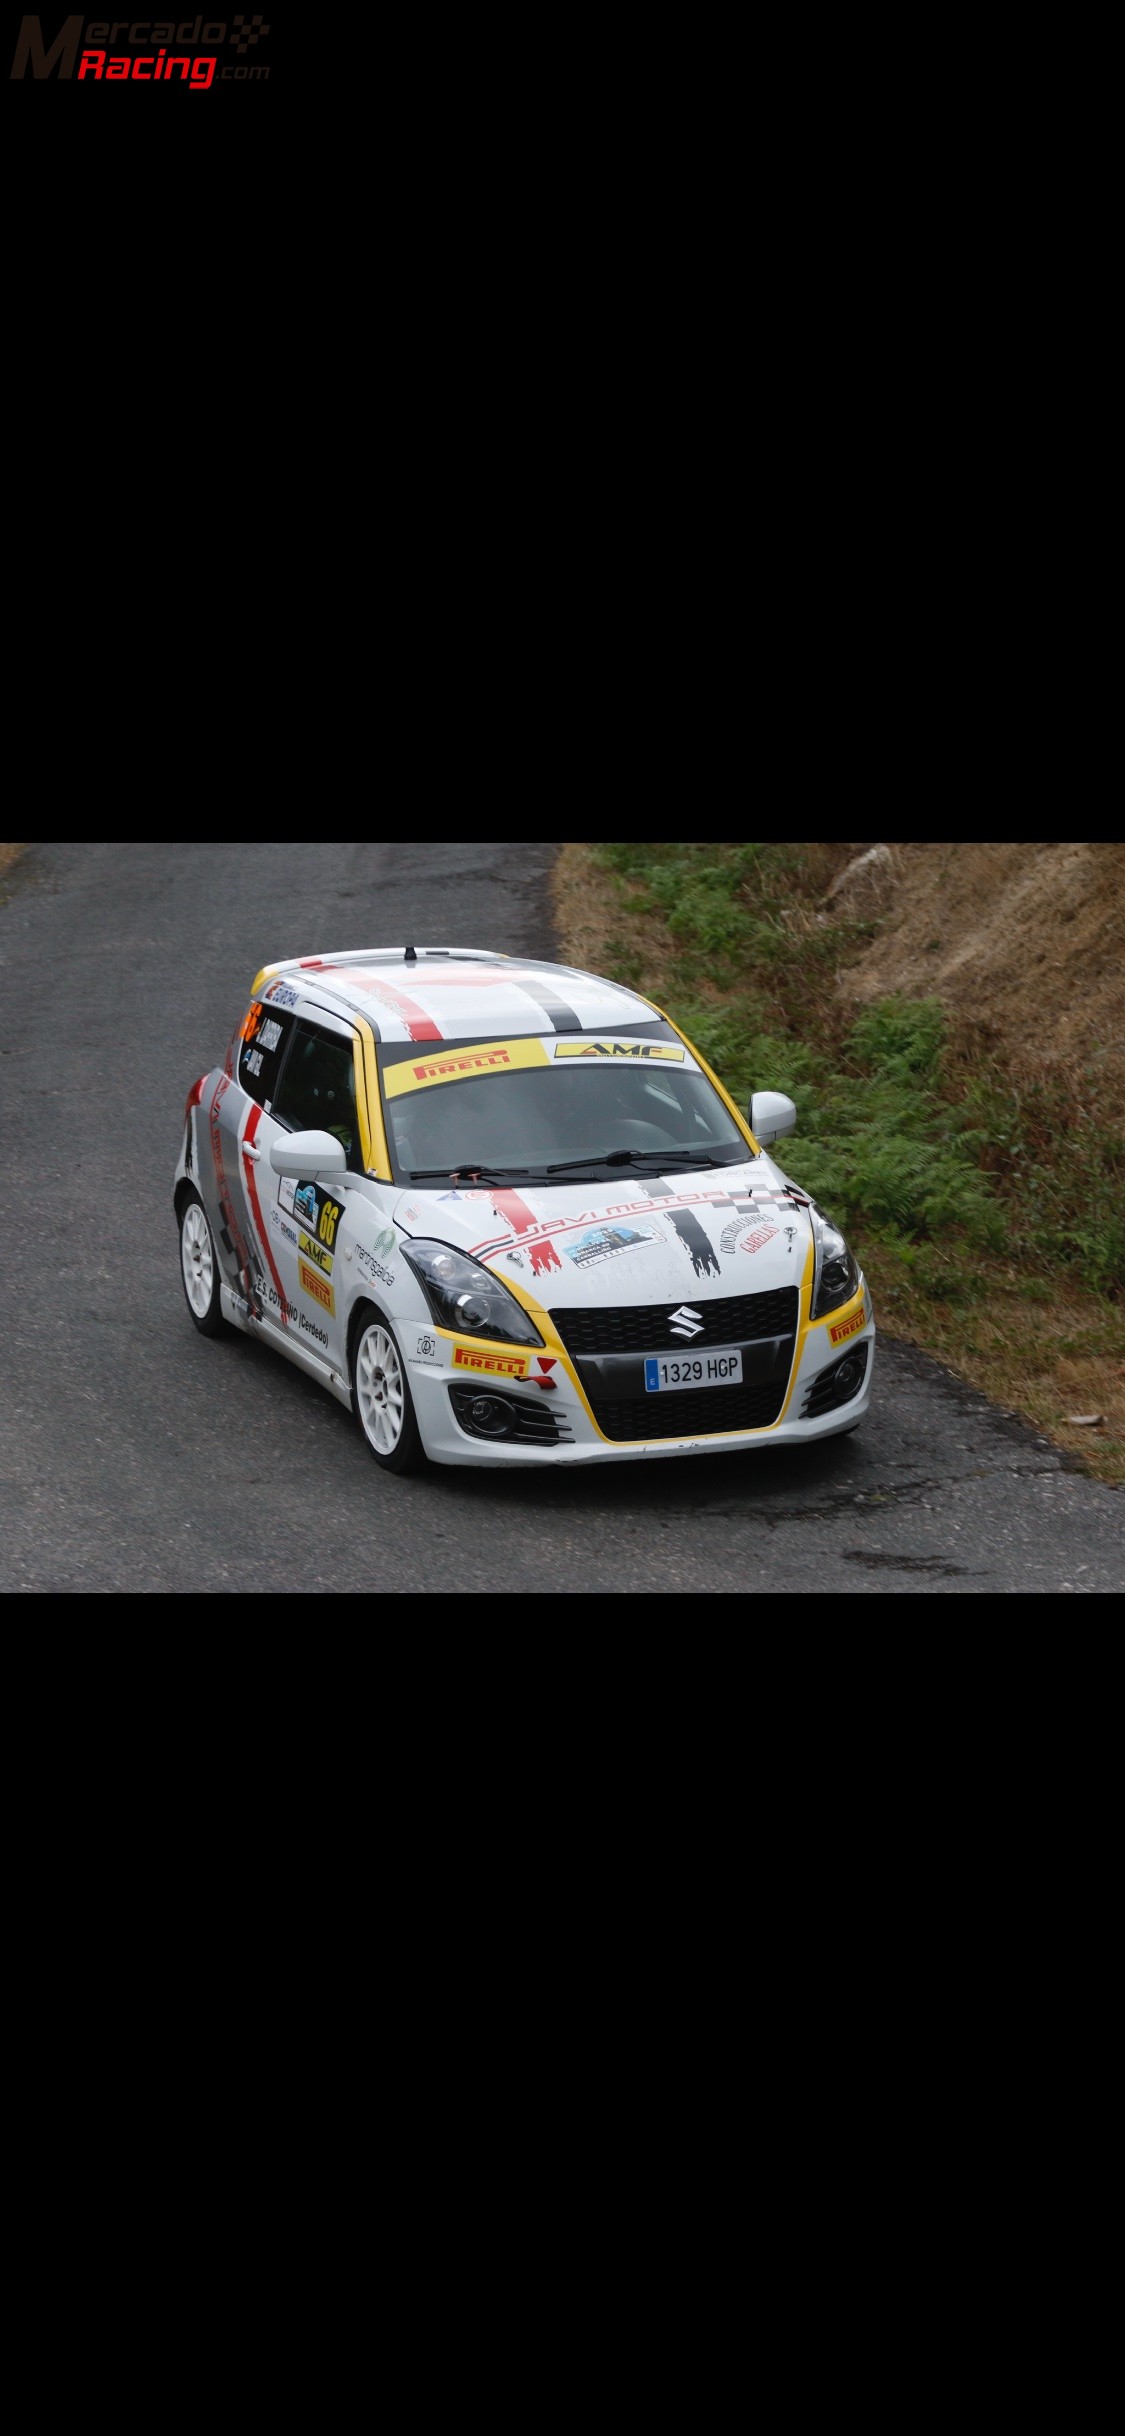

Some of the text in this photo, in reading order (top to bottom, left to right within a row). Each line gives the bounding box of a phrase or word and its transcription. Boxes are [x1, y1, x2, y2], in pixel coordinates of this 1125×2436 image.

[412, 1049, 511, 1080] PIRELLI
[580, 1043, 663, 1055] AMF
[320, 1201, 339, 1246] 66
[517, 1190, 727, 1241] JAVI MOTOR
[720, 1213, 774, 1254] CONSTRUCCIONES
[303, 1240, 327, 1265] AMF
[302, 1265, 331, 1308] PIRELLI
[299, 1311, 329, 1349] (Cerdedo)
[830, 1308, 865, 1343] PIRELLI
[454, 1348, 526, 1375] PIRELLI
[661, 1361, 703, 1384] 1329
[707, 1357, 739, 1379] HGP
